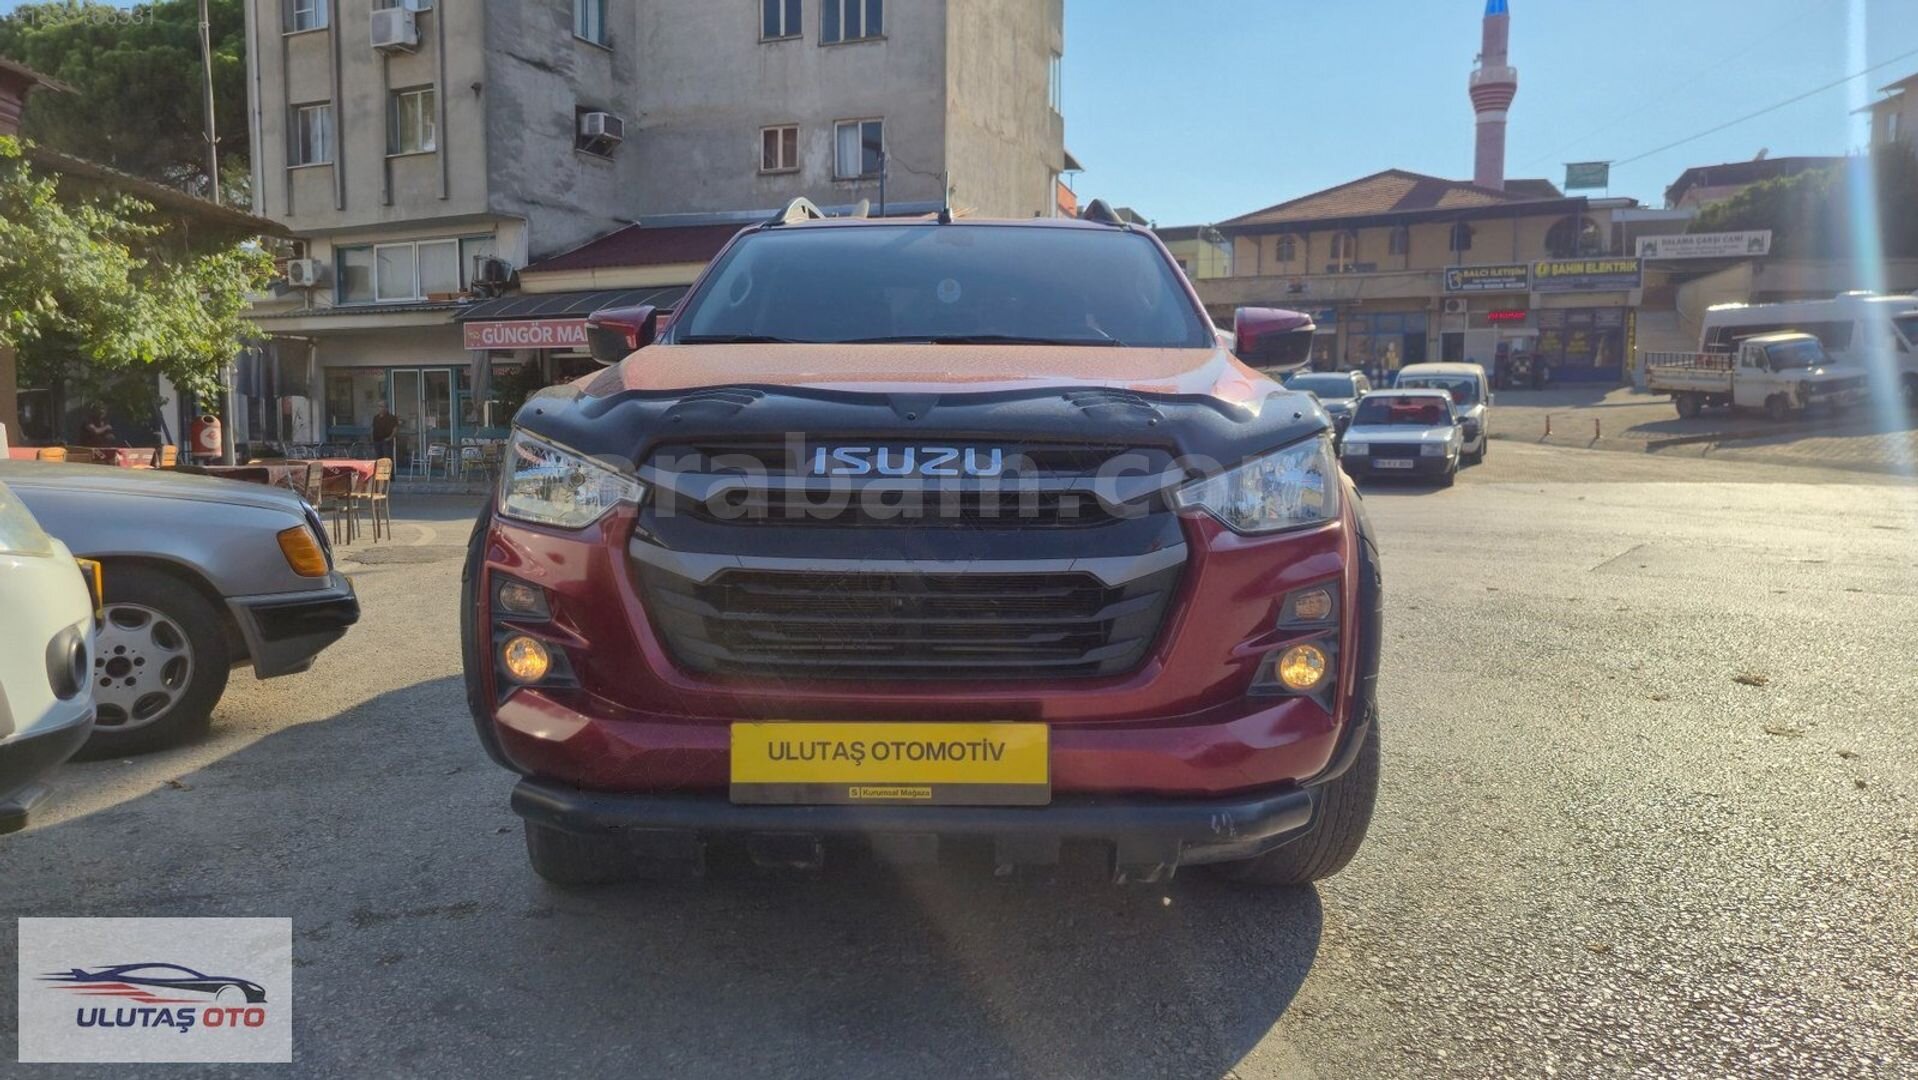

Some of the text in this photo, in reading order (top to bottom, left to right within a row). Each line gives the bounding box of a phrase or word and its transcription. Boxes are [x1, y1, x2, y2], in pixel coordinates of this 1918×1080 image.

[482, 323, 586, 344] GÜNGÖR MA
[813, 447, 1002, 476] ISUZU
[768, 738, 1006, 766] ULUTAŞ OTOMOTİV
[863, 789, 898, 797] Kurumsal
[900, 789, 930, 798] Mağaza
